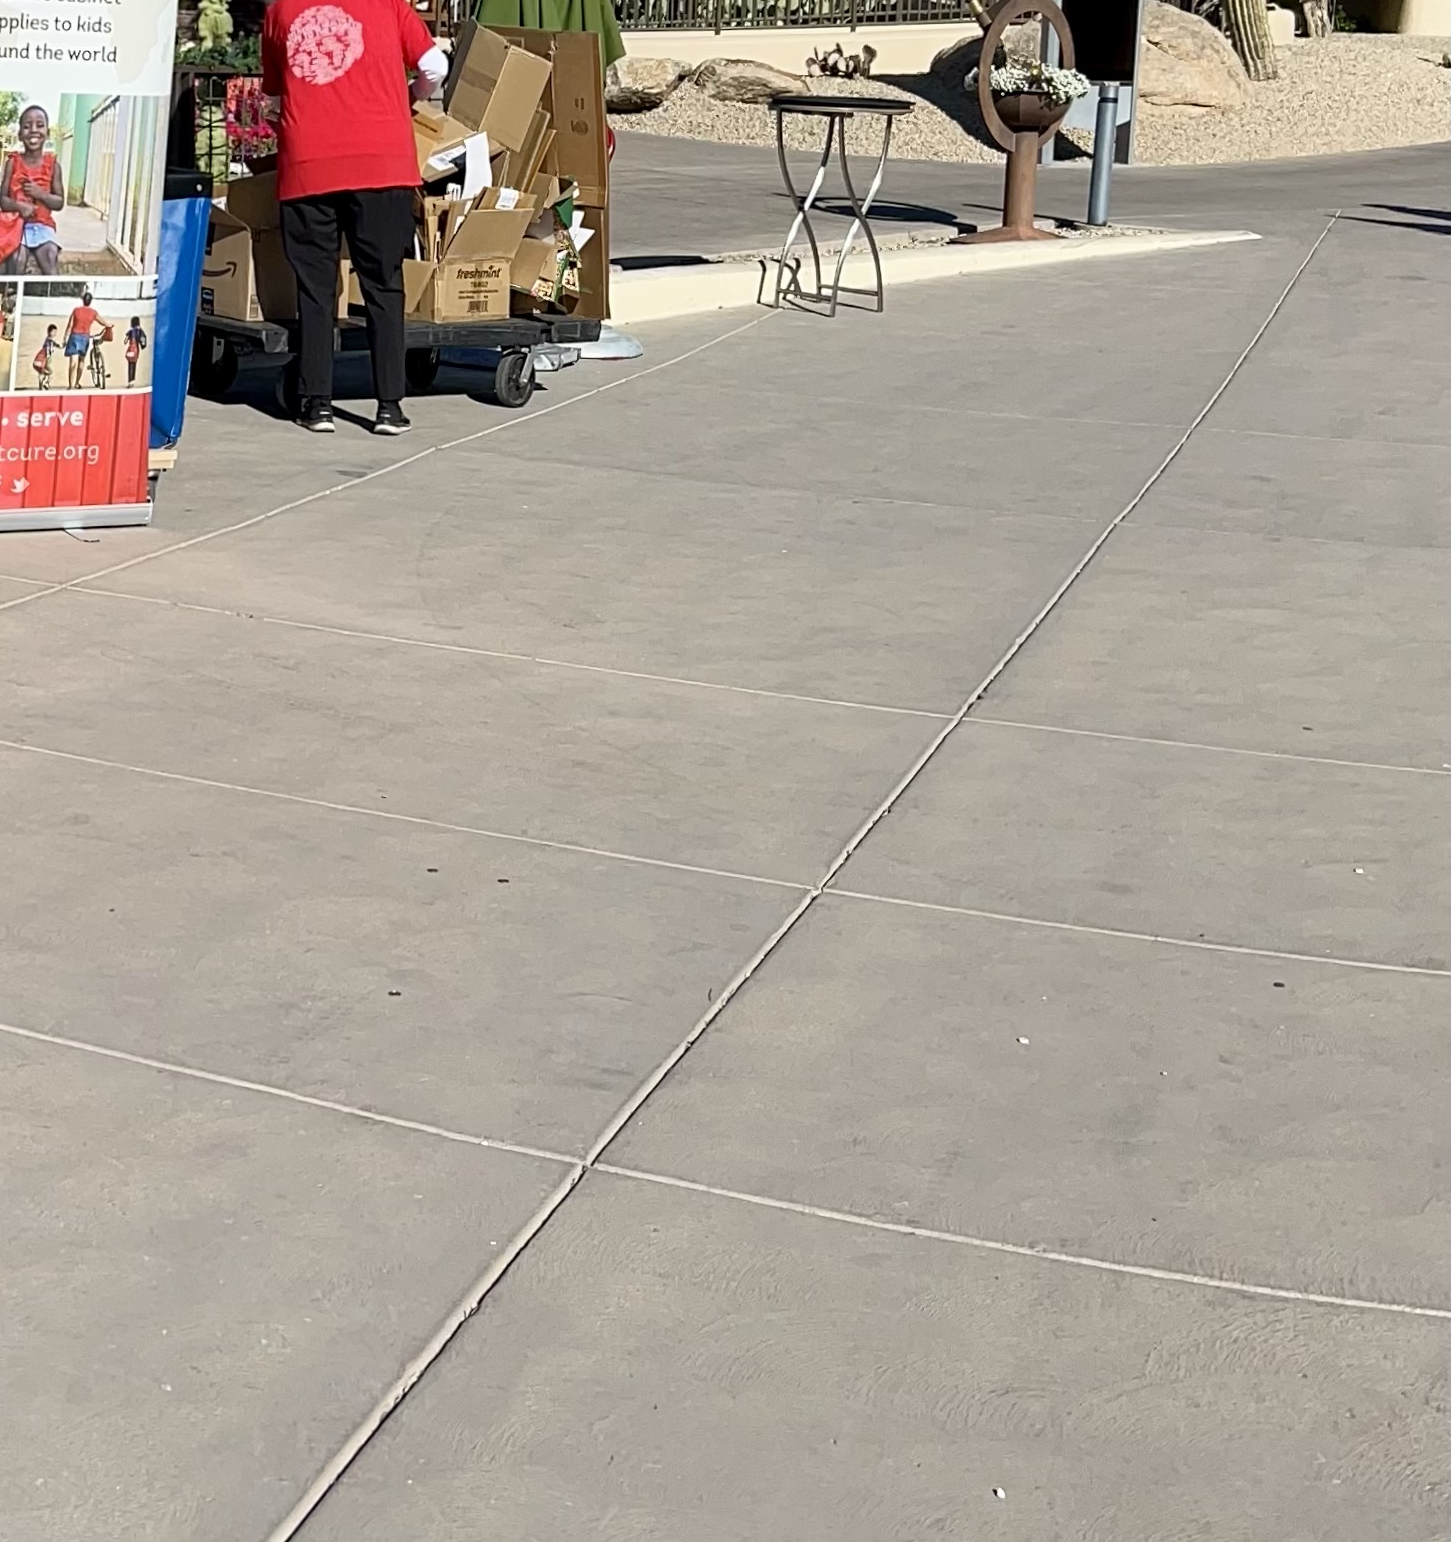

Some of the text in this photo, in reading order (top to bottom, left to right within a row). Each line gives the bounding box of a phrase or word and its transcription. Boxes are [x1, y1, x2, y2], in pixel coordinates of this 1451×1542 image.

[54, 15, 73, 33] to
[76, 16, 113, 34] kids
[35, 43, 65, 61] the
[67, 46, 118, 64] world
[456, 266, 501, 279] freshmint
[16, 409, 84, 429] serve
